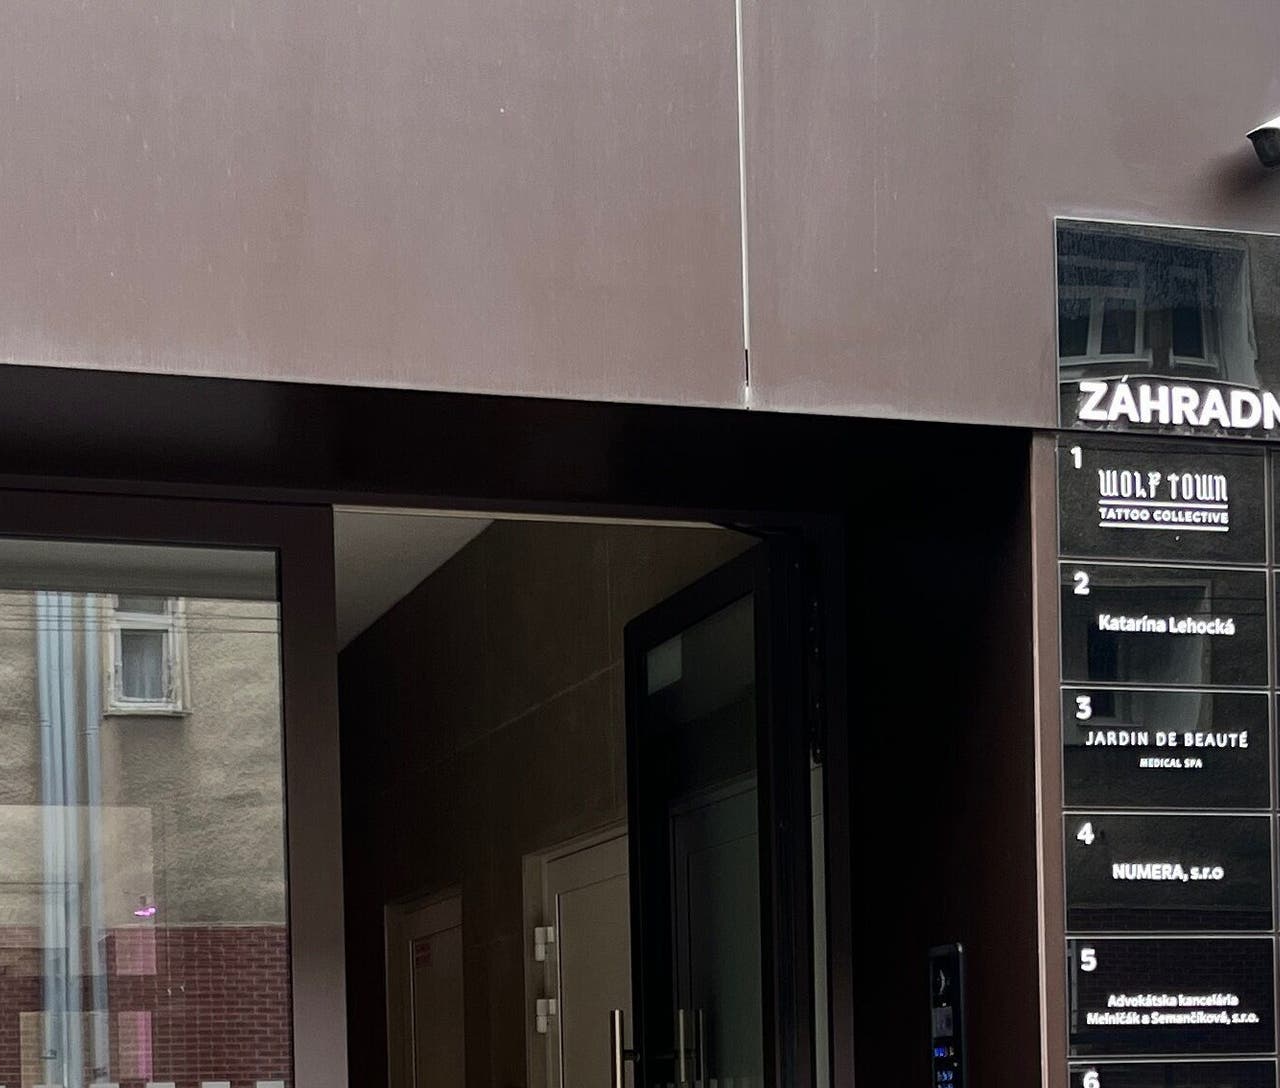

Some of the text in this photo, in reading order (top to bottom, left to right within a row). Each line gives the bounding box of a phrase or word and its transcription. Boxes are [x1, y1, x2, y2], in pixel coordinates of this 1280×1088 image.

[1071, 446, 1082, 468] 1
[1098, 469, 1228, 501] WOLF TOWN
[1099, 507, 1228, 524] TATTOO COLLECTIVE
[1074, 571, 1089, 594] 2
[1099, 614, 1235, 635] Katarína Lehocká
[1076, 696, 1091, 719] 3
[1086, 731, 1248, 748] JARDIN DE BEAUTÉ
[1140, 758, 1202, 768] MEDICAL SPA
[1077, 822, 1094, 844] 4
[1113, 863, 1224, 882] NUMERA, s.r.o
[1081, 948, 1097, 971] 5
[1108, 994, 1239, 1007] Advokátska kancelária
[1141, 1014, 1150, 1024] a
[1231, 1013, 1259, 1023] s.r.o.
